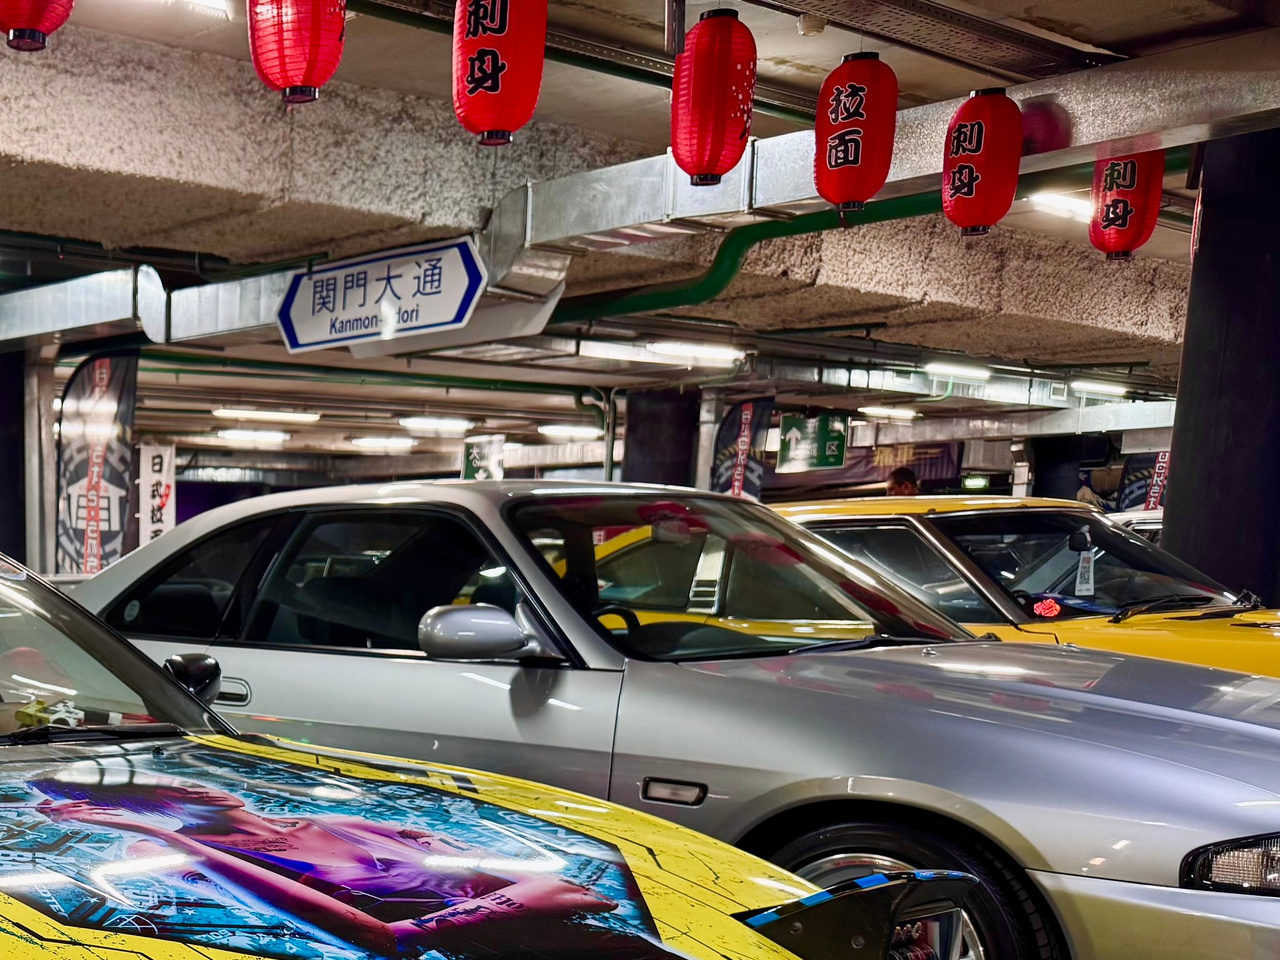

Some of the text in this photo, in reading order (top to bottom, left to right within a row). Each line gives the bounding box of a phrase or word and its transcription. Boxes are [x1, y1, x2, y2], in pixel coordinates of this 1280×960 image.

[827, 82, 867, 170] 拉面
[311, 256, 443, 317] 関門大通
